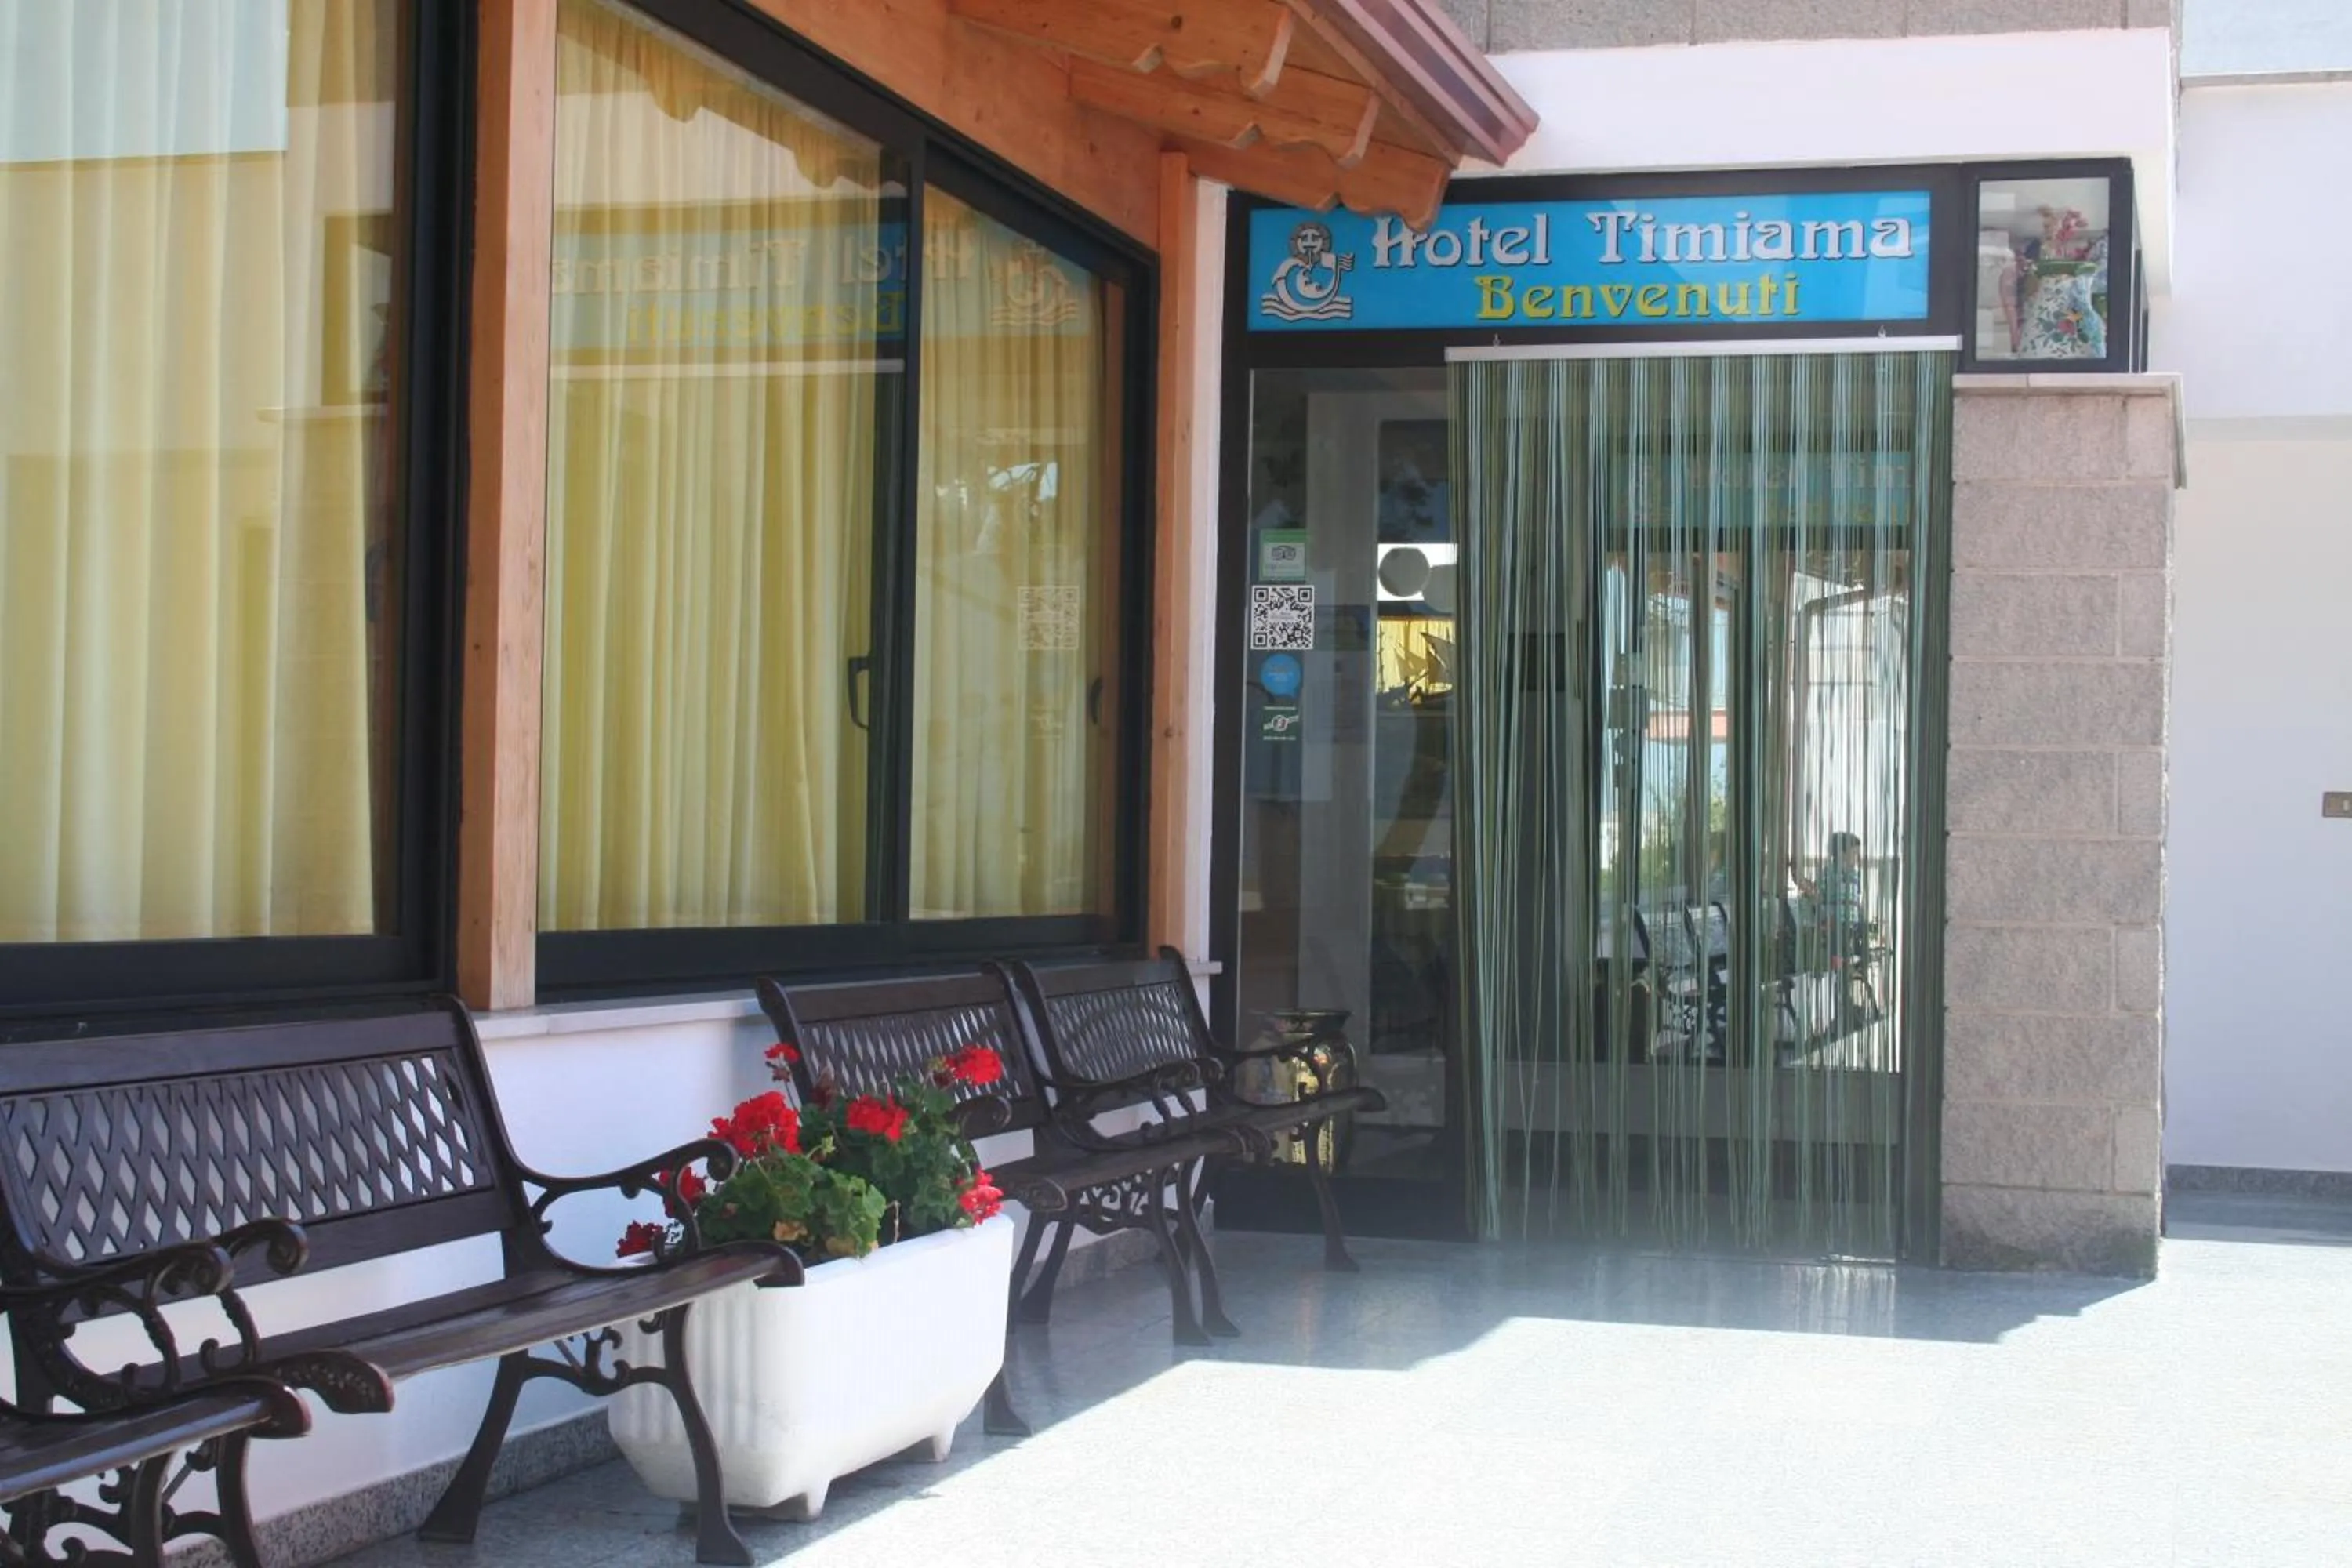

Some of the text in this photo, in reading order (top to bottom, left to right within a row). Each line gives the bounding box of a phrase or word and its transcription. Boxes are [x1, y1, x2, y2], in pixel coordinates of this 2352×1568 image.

[1372, 210, 1915, 267] Hotel Timiama
[1475, 271, 1801, 320] Benvenuti
